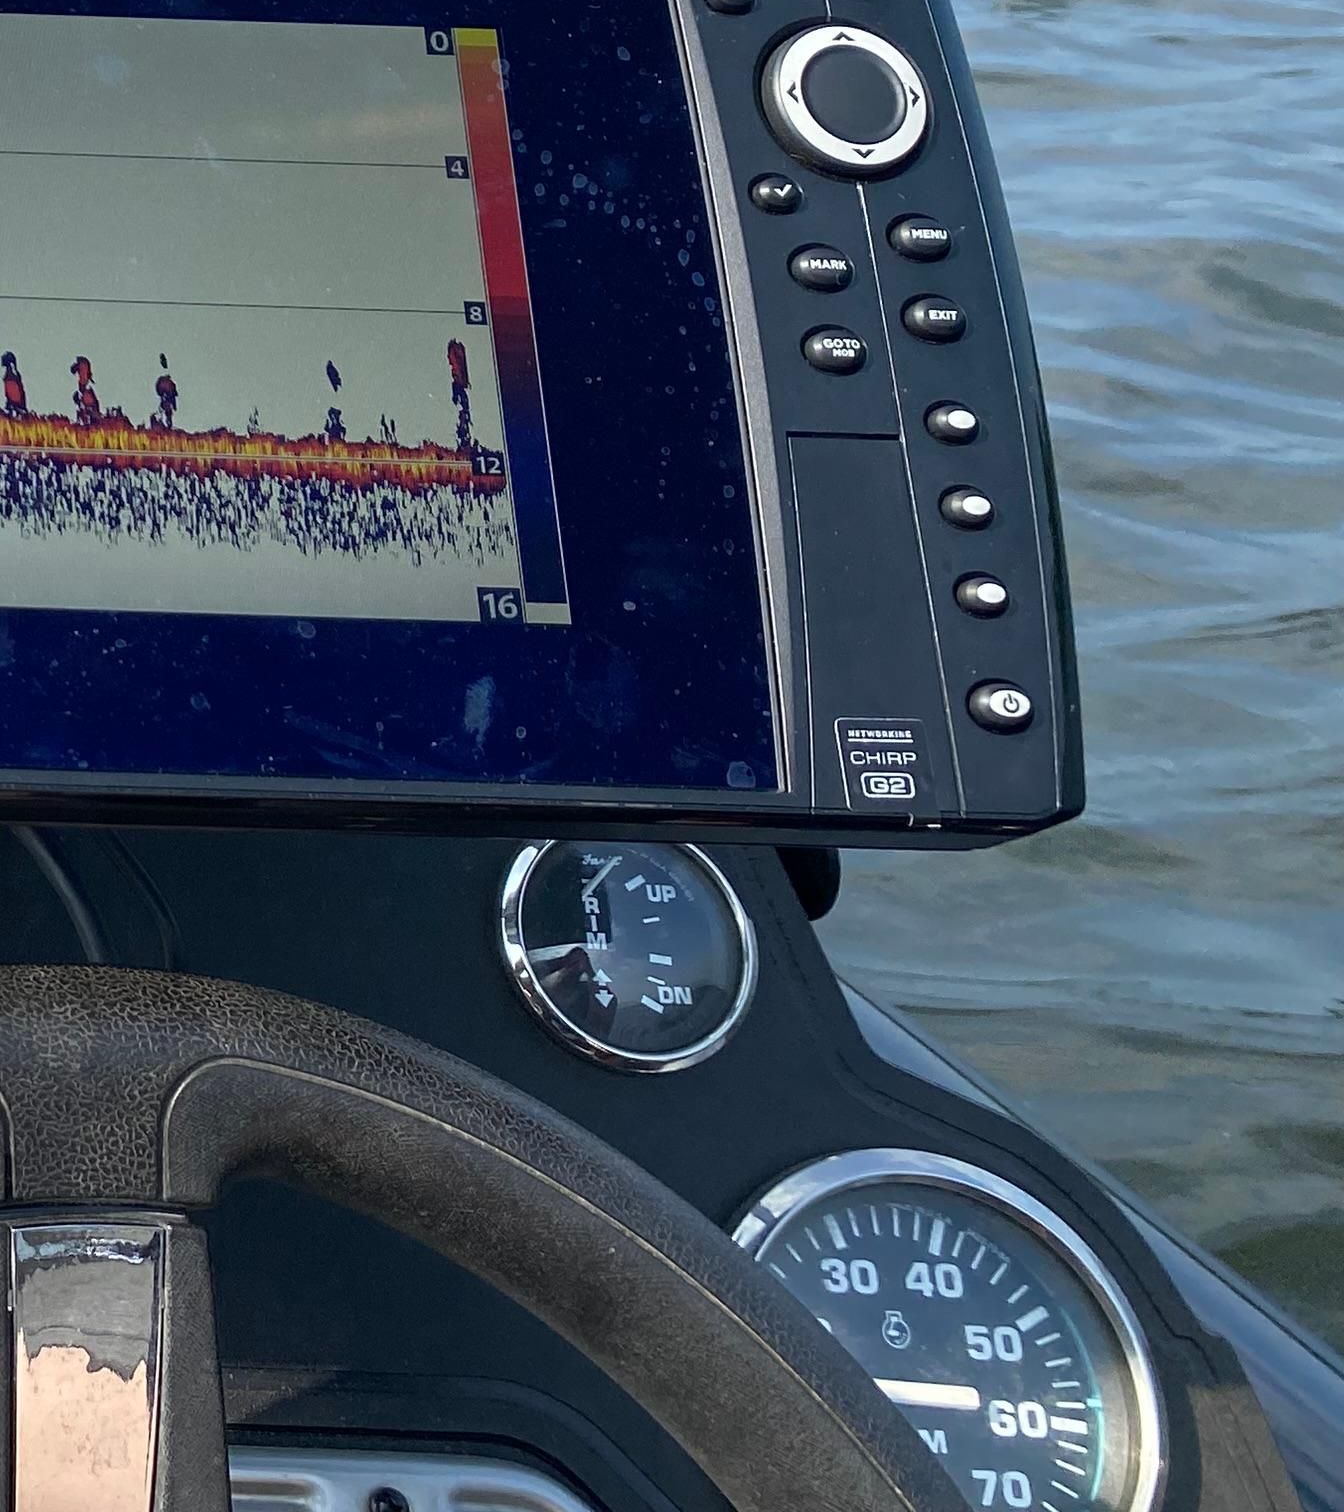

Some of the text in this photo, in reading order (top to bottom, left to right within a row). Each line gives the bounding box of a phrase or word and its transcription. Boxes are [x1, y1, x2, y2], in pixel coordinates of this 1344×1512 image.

[430, 31, 449, 52] 0
[450, 159, 464, 177] 4
[911, 227, 948, 241] MENU
[810, 259, 847, 271] MARK
[469, 306, 483, 323] 8
[928, 309, 958, 322] EXIT
[476, 456, 502, 475] 12
[483, 593, 519, 620] 16
[847, 729, 912, 738] NETWORKING
[850, 750, 917, 765] CHIRP
[869, 777, 907, 794] G2
[645, 883, 677, 903] UP
[657, 985, 693, 1006] DN
[819, 1258, 880, 1295] 30
[904, 1261, 964, 1299] 40
[963, 1324, 1024, 1362] 50
[987, 1399, 1049, 1439] 60
[971, 1469, 1033, 1508] 70
